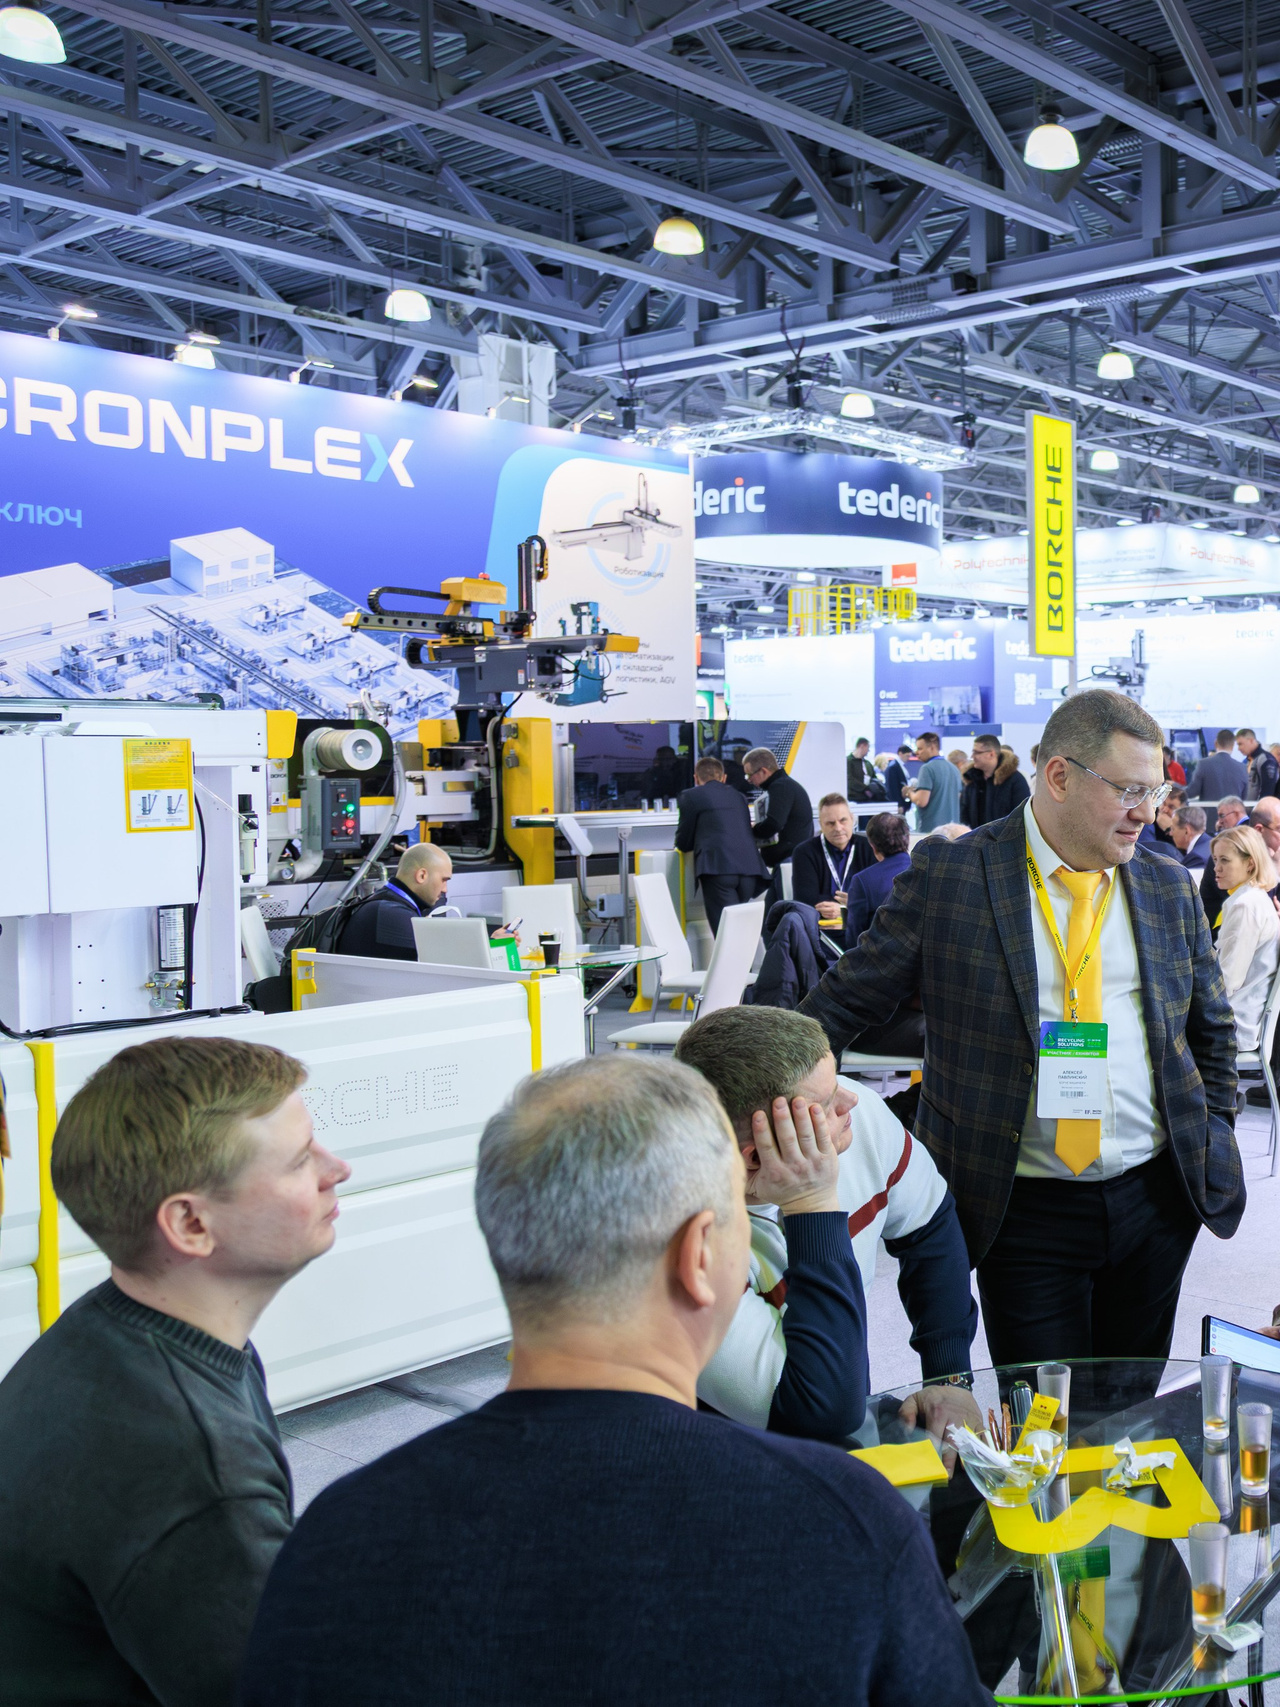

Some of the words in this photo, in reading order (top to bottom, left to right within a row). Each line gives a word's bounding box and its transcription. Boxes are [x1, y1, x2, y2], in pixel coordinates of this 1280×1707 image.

[0, 376, 415, 488] RONPLEX
[838, 481, 941, 529] tederic
[1046, 444, 1064, 632] BORCHE
[614, 566, 664, 578] Роботизация
[1190, 546, 1255, 568] Polytechnika
[889, 631, 977, 663] tederic
[622, 664, 664, 673] складской
[660, 676, 676, 685] AGV
[1026, 856, 1043, 890] BORCHE
